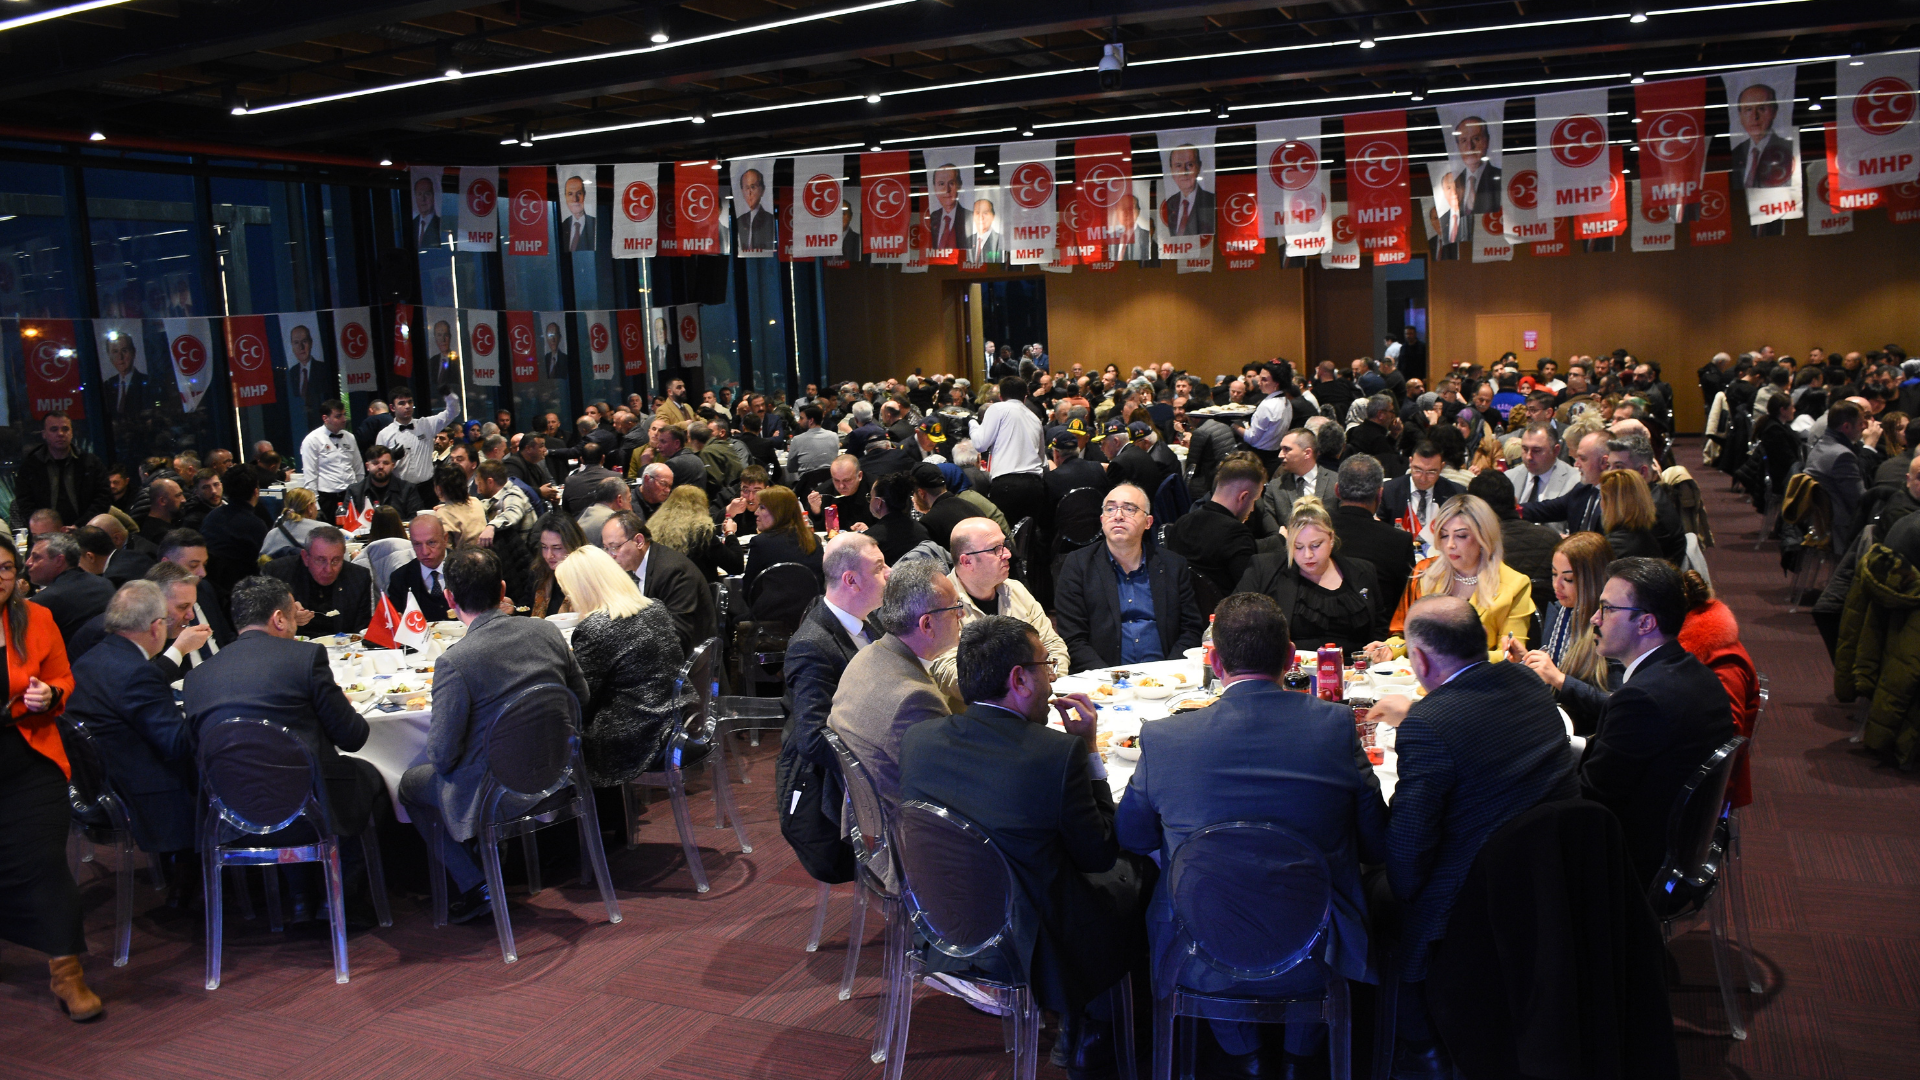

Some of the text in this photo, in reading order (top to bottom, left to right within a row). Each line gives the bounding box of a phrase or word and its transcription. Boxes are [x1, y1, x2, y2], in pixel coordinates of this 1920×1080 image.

[1858, 154, 1913, 176] MHP
[1556, 186, 1603, 205] MHP
[1652, 181, 1697, 200] MHP
[1839, 192, 1879, 208] MHP
[1274, 208, 1316, 225] MHP
[1357, 206, 1402, 224] MHP
[1582, 219, 1618, 234] MHP
[1821, 216, 1850, 229] MHP
[468, 231, 494, 243] MHP
[1013, 225, 1050, 240] MHP
[1087, 225, 1126, 240] MHP
[1696, 230, 1726, 242] MHP
[624, 238, 653, 250] MHP
[661, 240, 677, 249] MH
[683, 238, 714, 250] MHP
[805, 233, 838, 247] MHP
[870, 235, 904, 249] MHP
[1226, 239, 1258, 252] MHP
[1364, 235, 1398, 248] MHP
[1643, 234, 1671, 245] MHP
[515, 240, 542, 252] MHP
[1067, 245, 1095, 256] MHP
[1163, 243, 1193, 254] MHP
[1484, 247, 1511, 256] MHP
[1536, 243, 1564, 254] MHP
[926, 248, 953, 257] MHP
[1016, 248, 1044, 259] MHP
[1379, 252, 1405, 262] MHP
[1187, 259, 1211, 268] MHP
[1230, 259, 1255, 269] MHP
[1331, 254, 1357, 264] MHP
[1092, 262, 1114, 270] MHP
[684, 353, 698, 362] MHP
[346, 372, 371, 384] MHP
[474, 368, 495, 379] MHP
[239, 384, 268, 398] MHP
[37, 398, 73, 412] MHP
